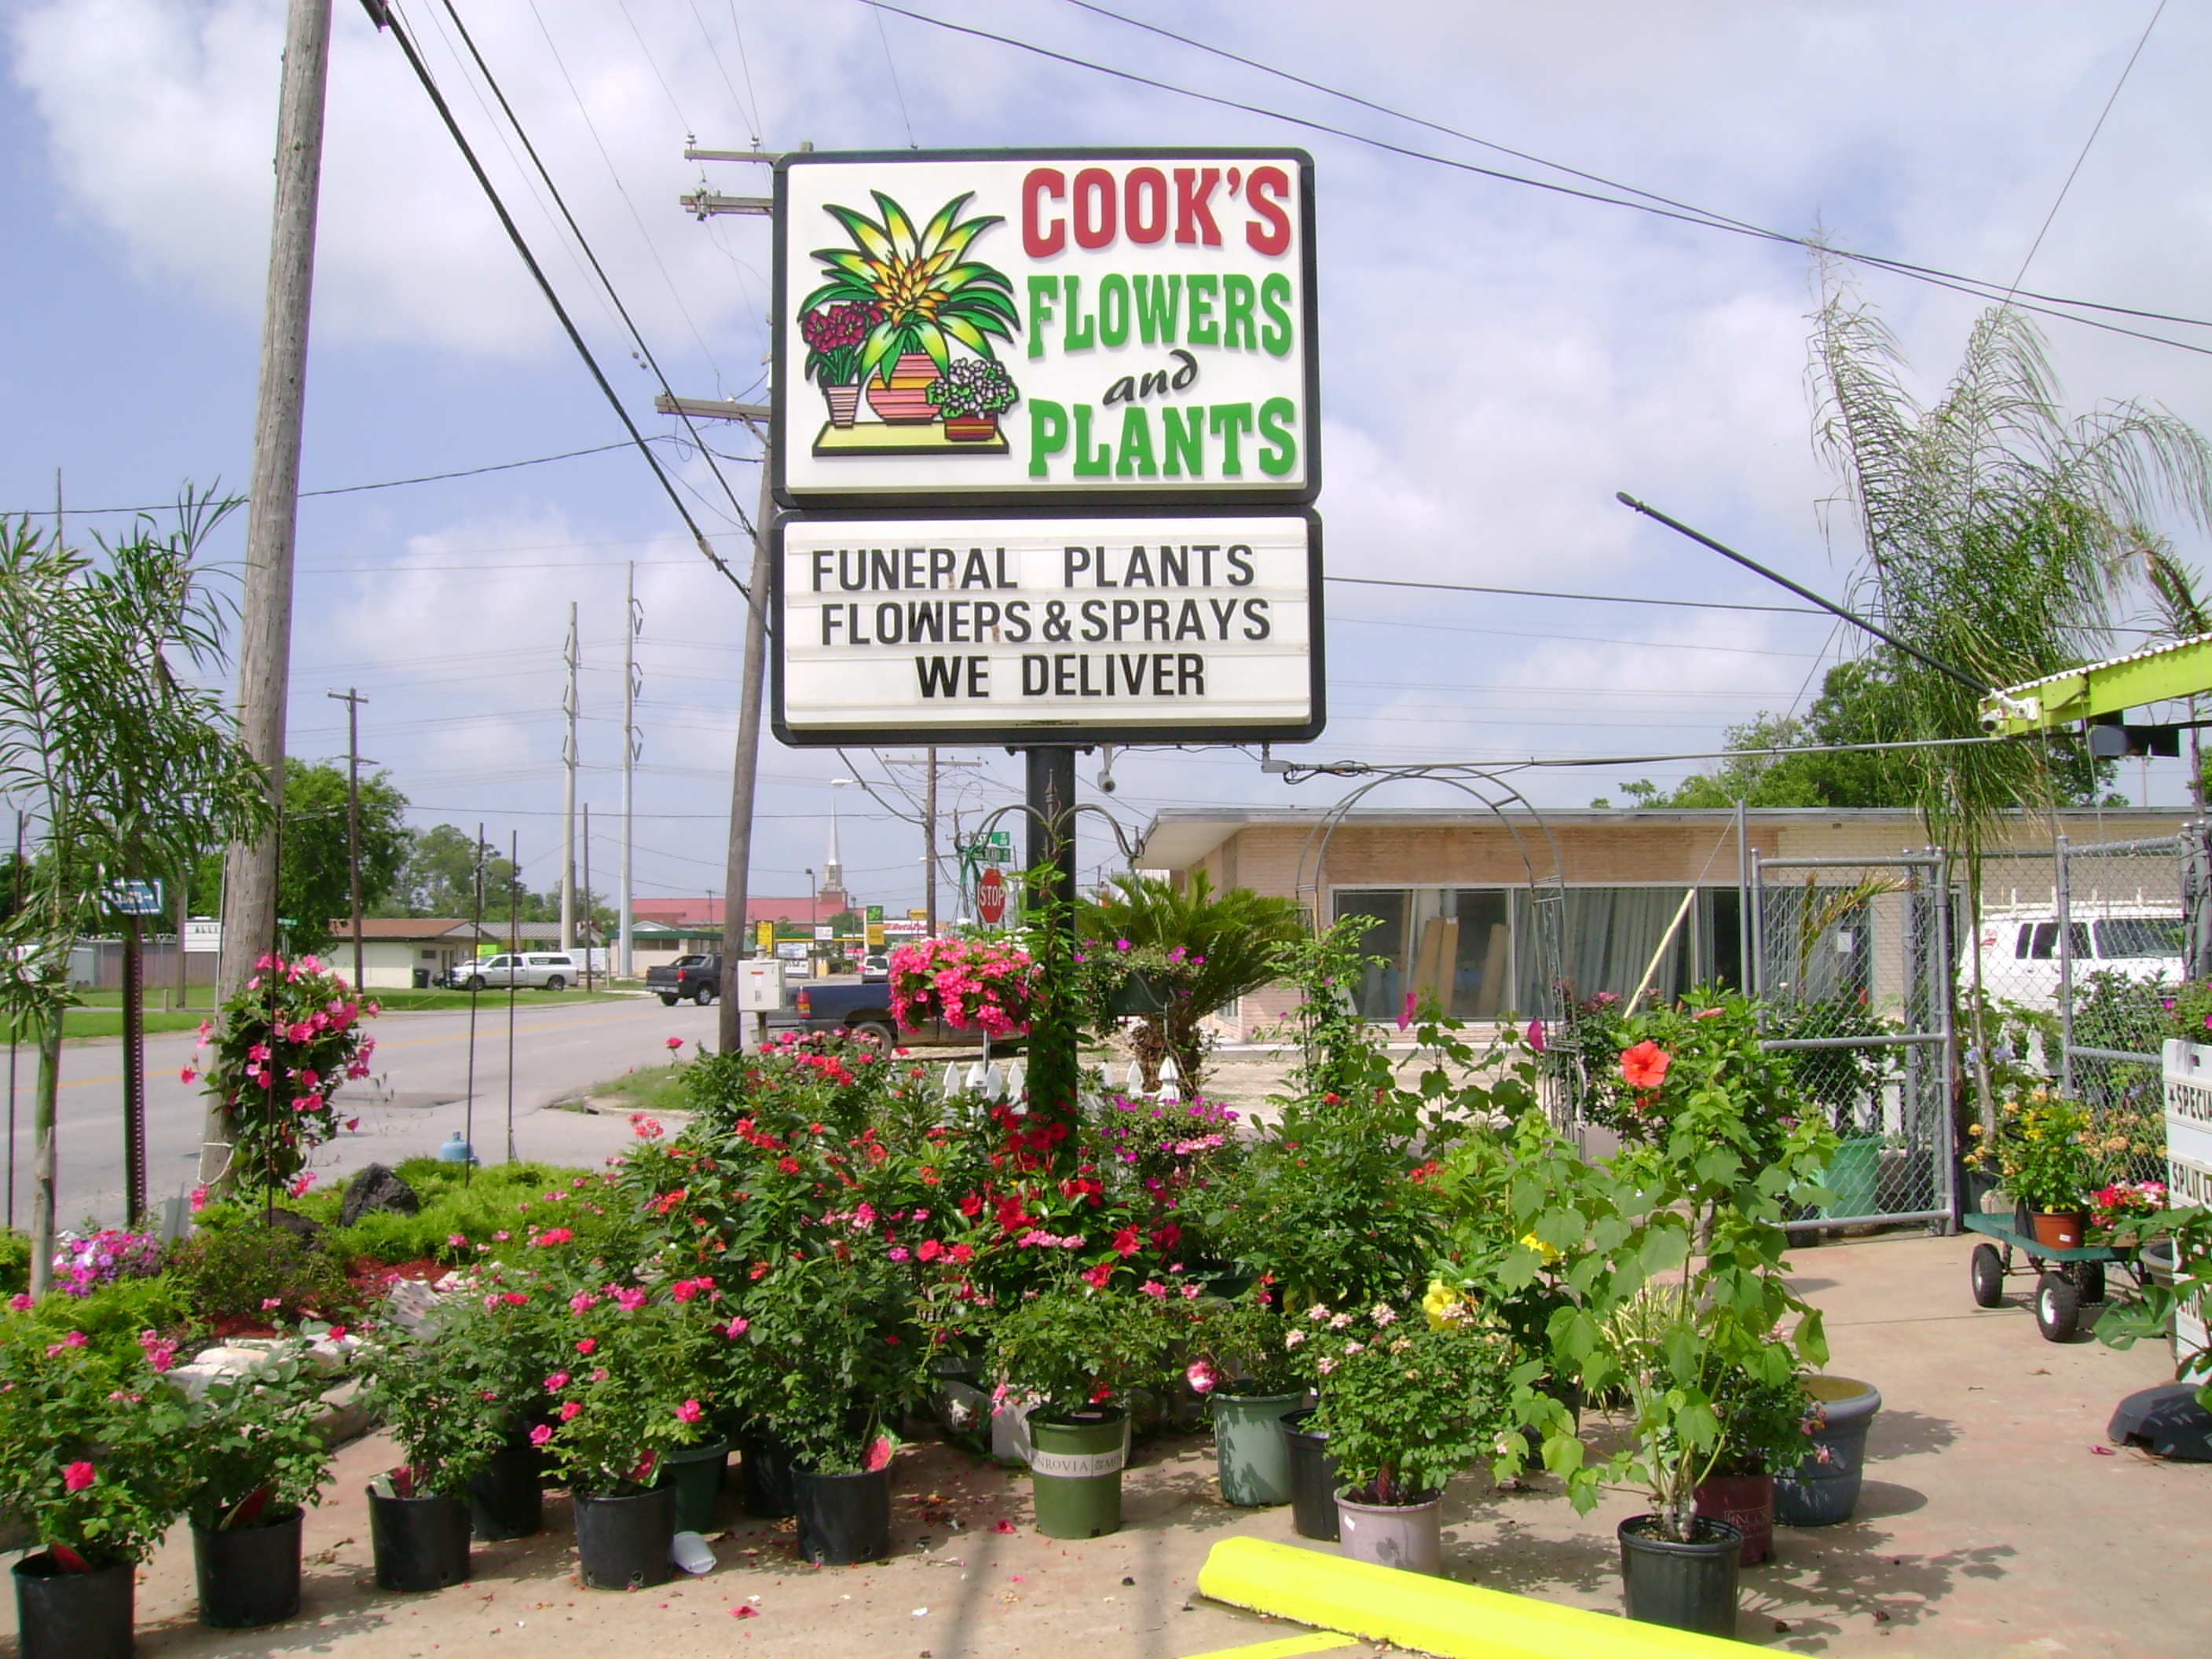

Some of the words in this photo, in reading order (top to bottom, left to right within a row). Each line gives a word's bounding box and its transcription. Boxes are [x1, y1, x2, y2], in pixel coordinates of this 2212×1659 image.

[1022, 167, 1291, 258] COOK'S
[1027, 272, 1291, 358] FLOWERS
[1103, 350, 1197, 405] and
[1028, 397, 1296, 476] PLANTS
[812, 548, 1018, 591] FUNERAL
[1064, 544, 1254, 588] PLANTS
[915, 655, 989, 698] WE
[1022, 653, 1204, 697] DELIVER
[980, 885, 1005, 906] STOP
